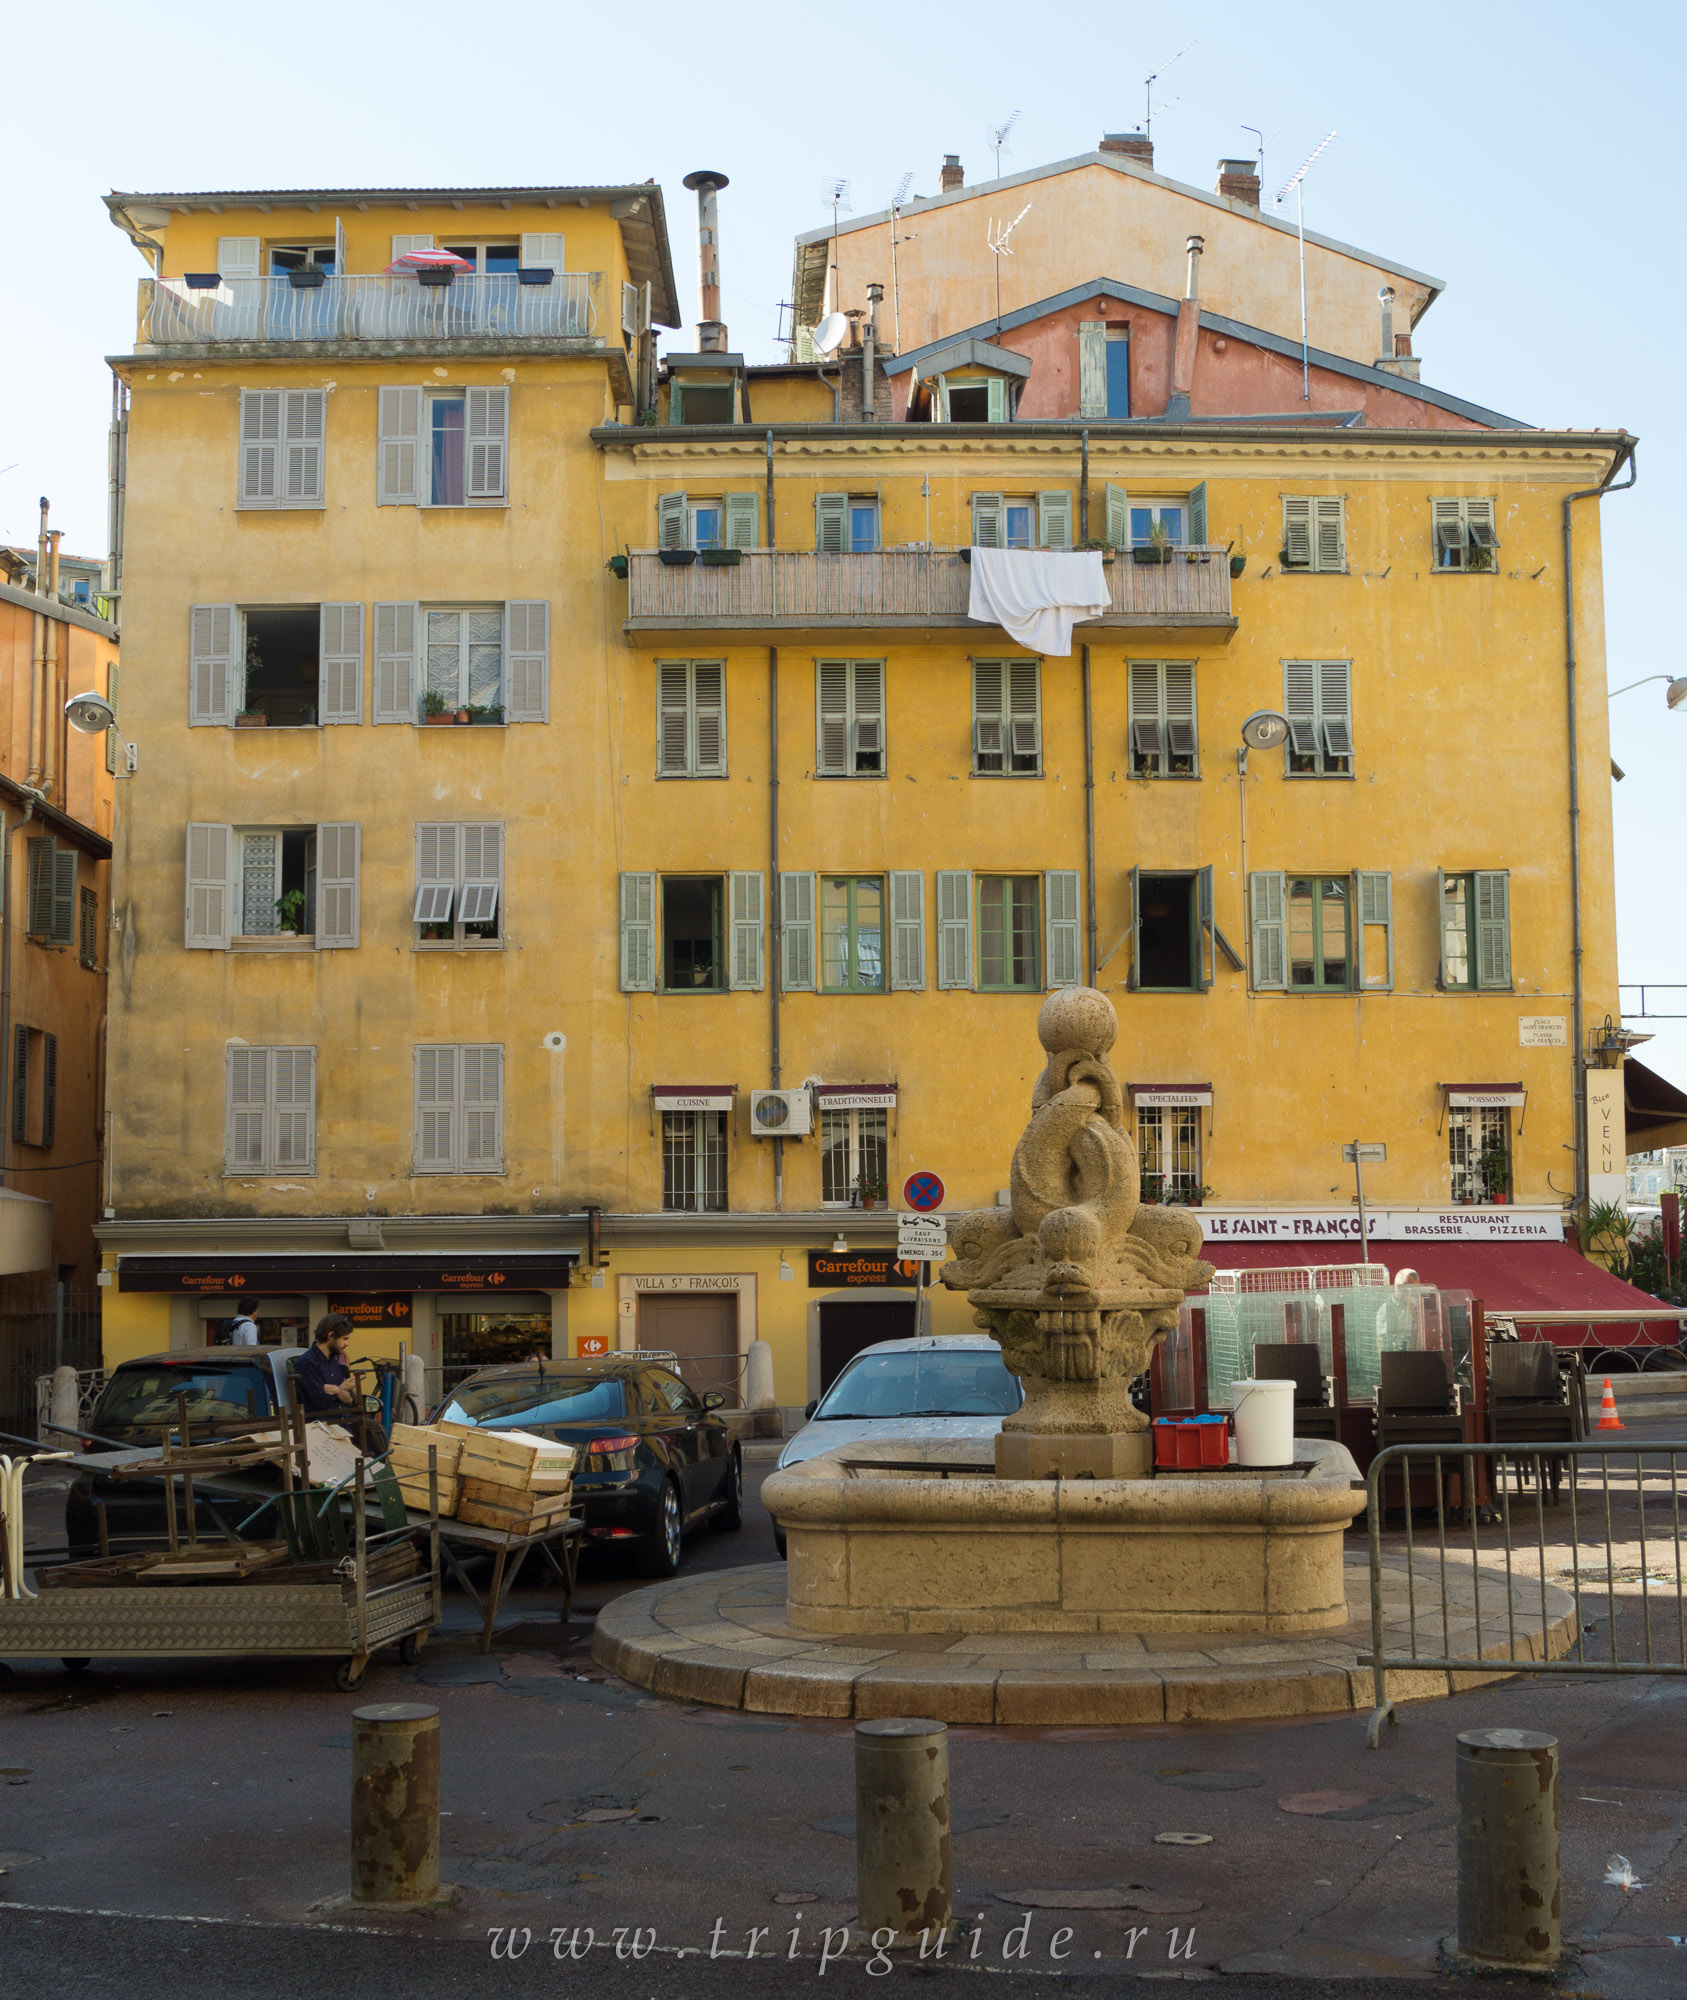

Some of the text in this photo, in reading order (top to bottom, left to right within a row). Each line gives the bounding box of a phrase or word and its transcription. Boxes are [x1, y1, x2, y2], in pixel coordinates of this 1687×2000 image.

[677, 1098, 710, 1107] CUISINE
[822, 1096, 894, 1106] TRADITIONNELLE
[1148, 1095, 1198, 1103] SPECIALITES
[1601, 1108, 1612, 1174] VENU
[1439, 1215, 1511, 1225] RESTAURANT
[1210, 1219, 1229, 1234] LE
[1232, 1219, 1278, 1235] SAINT
[1404, 1226, 1548, 1234] BRASSERIE PIZZERIA
[815, 1259, 888, 1273] Carrefour
[182, 1276, 226, 1285] Carrefour
[441, 1273, 486, 1283] Carrefour
[636, 1278, 665, 1288] VILLA
[689, 1277, 740, 1288] FRANÇOIS
[847, 1275, 887, 1284] express
[330, 1303, 384, 1314] Carrefour
[623, 1302, 631, 1313] 7
